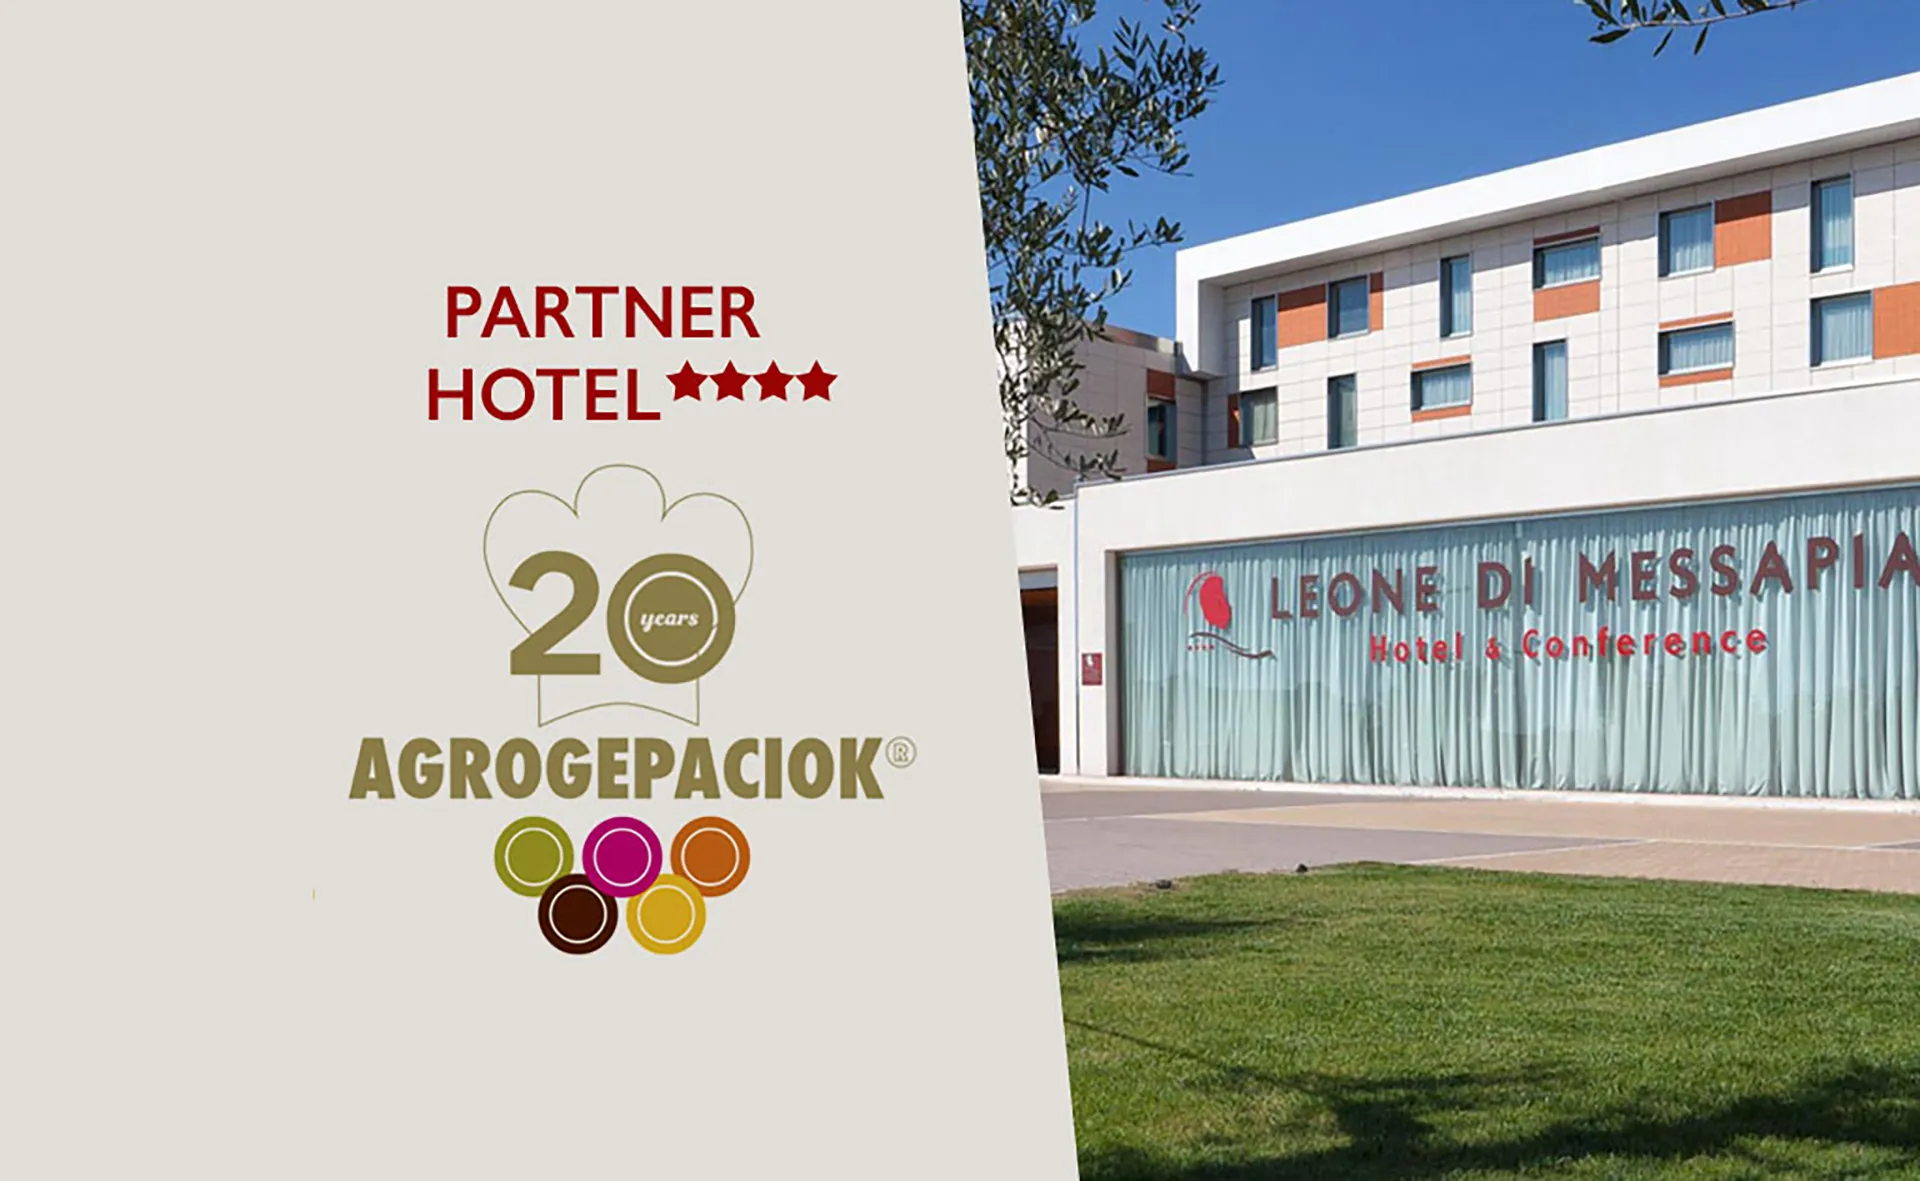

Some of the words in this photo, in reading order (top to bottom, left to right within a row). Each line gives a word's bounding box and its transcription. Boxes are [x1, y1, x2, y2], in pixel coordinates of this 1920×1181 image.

[1271, 567, 1438, 620] LEONE
[1477, 557, 1533, 609] DI
[1580, 532, 1920, 603] MESSAPIA
[1370, 631, 1463, 663] Hotel
[1486, 637, 1501, 660] &
[1523, 626, 1768, 659] Conference
